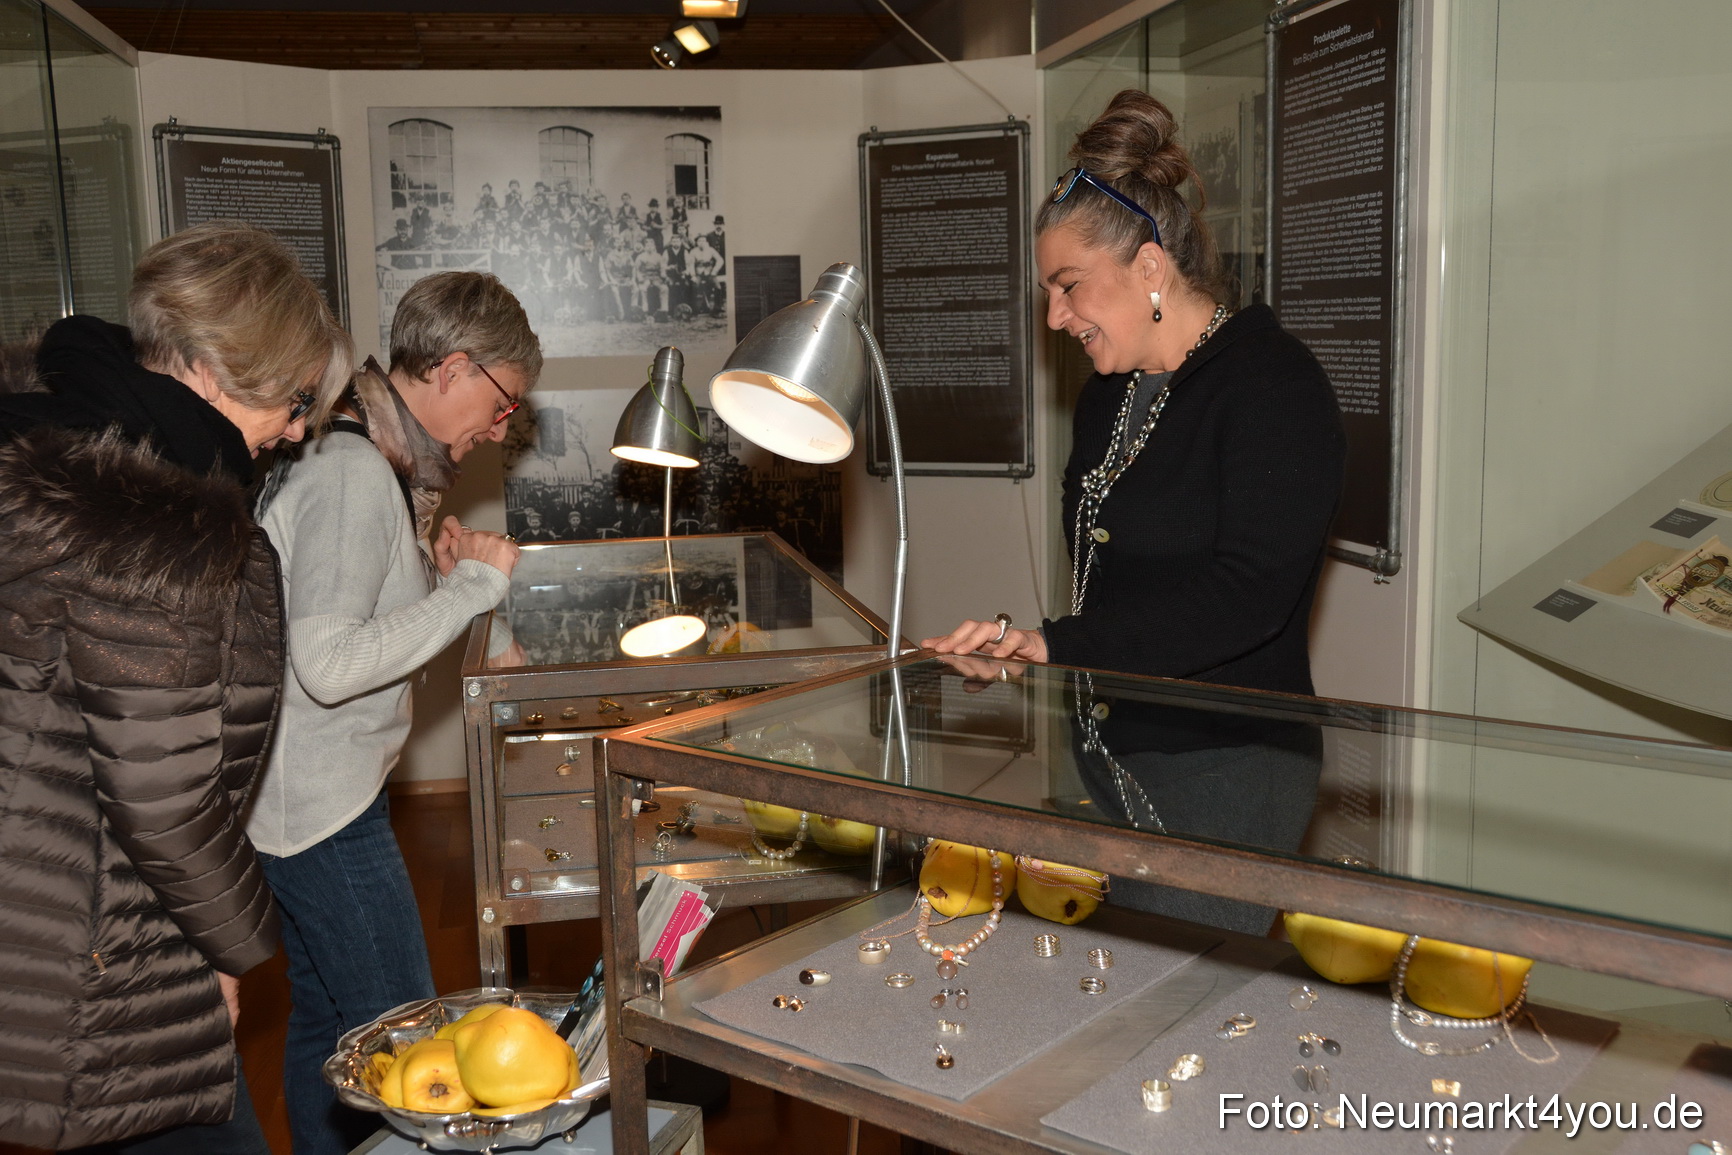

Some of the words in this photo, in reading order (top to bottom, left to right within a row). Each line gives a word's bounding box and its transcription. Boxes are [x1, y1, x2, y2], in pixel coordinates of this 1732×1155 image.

[1313, 24, 1351, 45] Produktpalette
[1302, 50, 1318, 63] Bicycle
[1319, 47, 1329, 57] zum
[1329, 28, 1375, 53] Sicherheitsfahrrad
[221, 157, 284, 168] Aktiengesellschaft
[925, 153, 959, 162] Expansion
[200, 165, 218, 173] Neue
[219, 166, 236, 174] Form
[237, 167, 246, 175] für
[263, 169, 304, 177] Unternehmen
[666, 899, 687, 934] Schmuck
